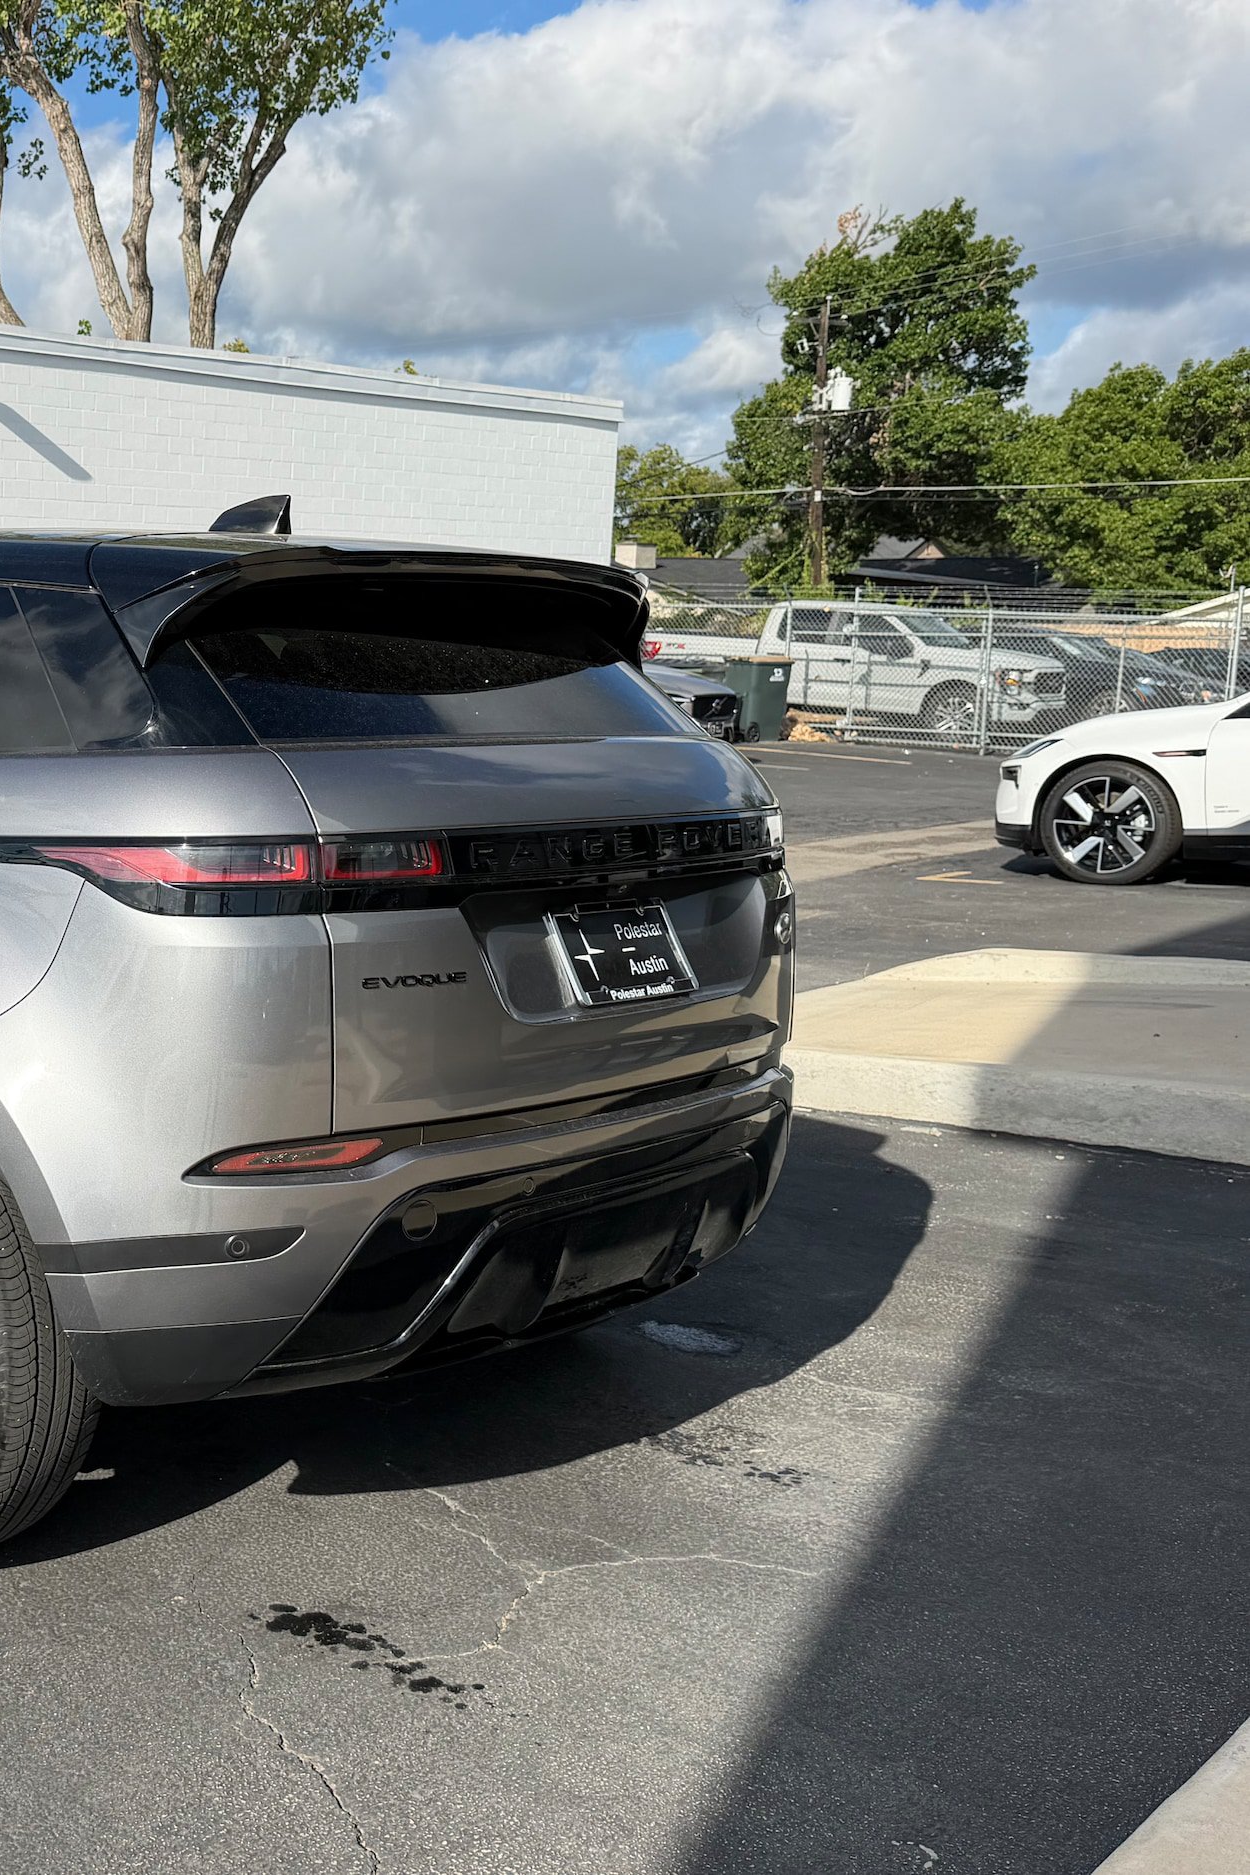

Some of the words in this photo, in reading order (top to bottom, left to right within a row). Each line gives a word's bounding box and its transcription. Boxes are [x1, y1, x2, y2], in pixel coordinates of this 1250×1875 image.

[470, 832, 634, 869] RANGE
[656, 817, 770, 853] ROVER
[613, 921, 663, 941] Polestar
[629, 954, 669, 976] Austin
[361, 971, 467, 990] EVOQUE
[610, 986, 646, 1001] Polestar
[647, 982, 674, 997] Austin
